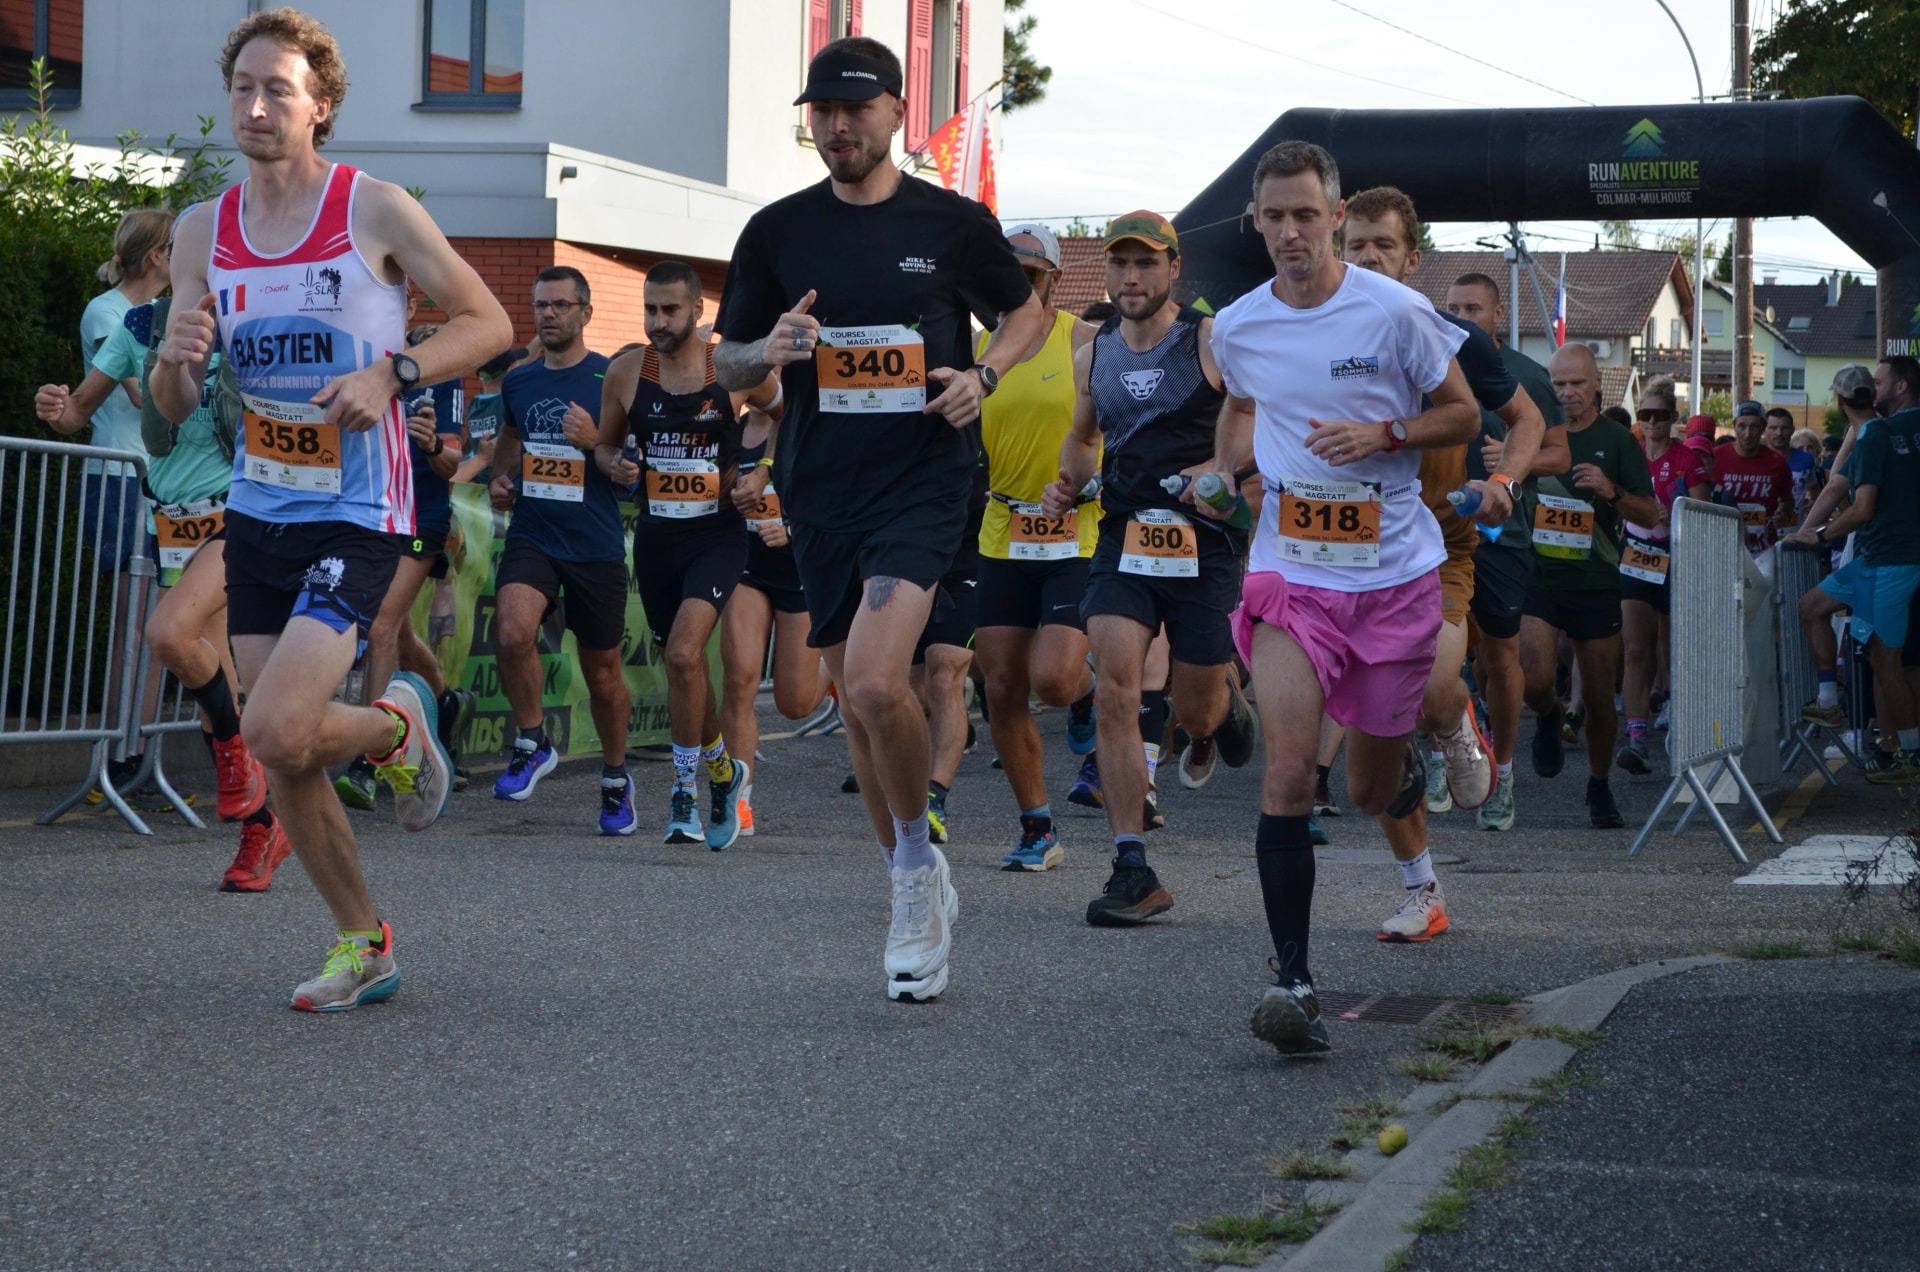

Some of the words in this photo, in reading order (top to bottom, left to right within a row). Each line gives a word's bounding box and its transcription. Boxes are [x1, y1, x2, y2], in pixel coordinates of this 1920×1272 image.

[842, 71, 877, 81] SALOMON
[1588, 160, 1700, 182] RUNAVENTURE
[1596, 191, 1693, 205] COLMAR-MULHOUSE
[314, 284, 342, 296] SLRC
[232, 332, 334, 368] BASTIEN
[846, 337, 890, 346] MAGSTATT
[1886, 338, 1920, 357] RUNA
[835, 348, 905, 378] 340
[269, 375, 320, 390] RUNNING
[252, 400, 280, 412] COURSES
[265, 410, 304, 422] MAGSTATT
[258, 420, 320, 455] 358
[652, 432, 709, 445] TARGET
[691, 442, 720, 459] TEAM
[531, 458, 572, 478] 223
[659, 475, 706, 494] 206
[1293, 480, 1323, 492] COURSES
[1723, 473, 1772, 482] MULHOUSE
[1305, 491, 1347, 500] MAGSTATT
[1294, 501, 1360, 532] 318
[1544, 509, 1582, 528] 218
[169, 517, 217, 541] 202
[1020, 516, 1065, 536] 362
[1138, 525, 1183, 549] 360
[1630, 551, 1661, 568] 280
